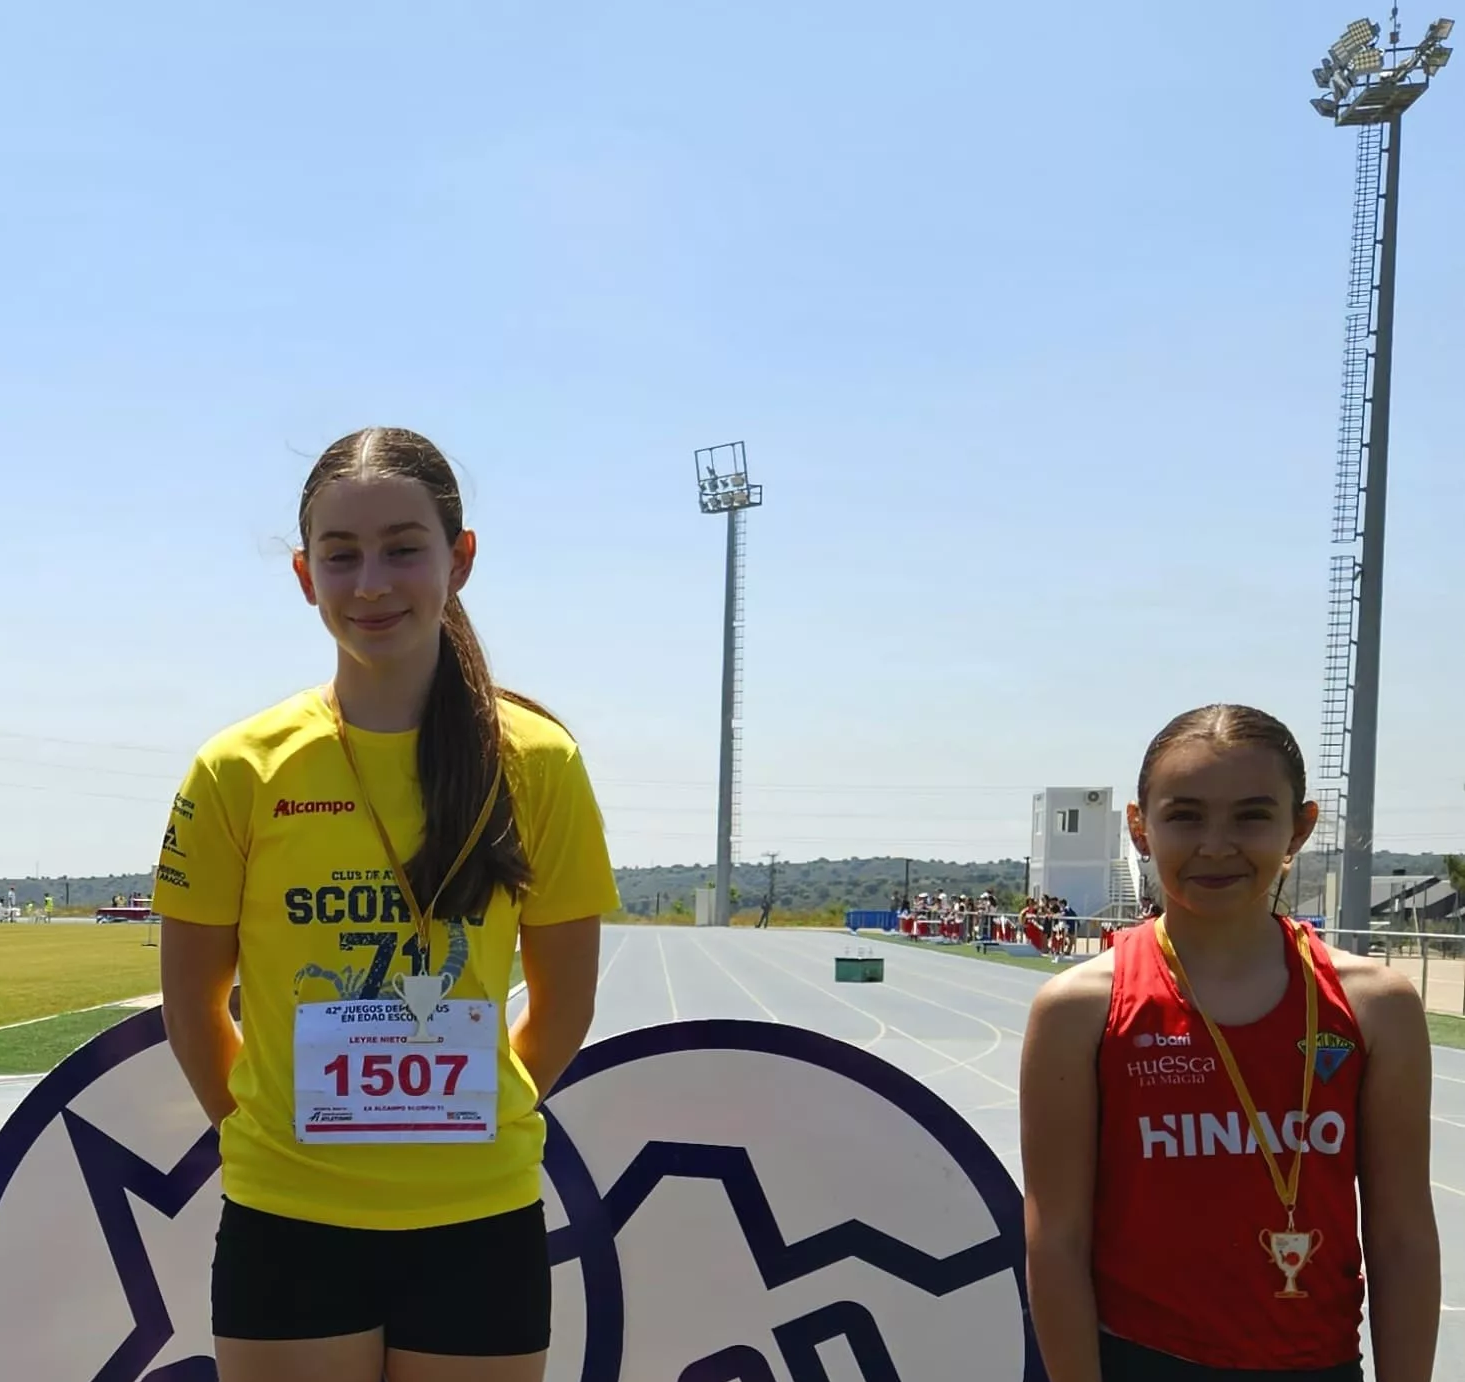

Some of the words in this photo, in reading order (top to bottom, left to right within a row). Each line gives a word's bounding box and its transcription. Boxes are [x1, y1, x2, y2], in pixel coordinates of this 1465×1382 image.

[273, 799, 355, 818] Alcampo
[332, 871, 362, 880] CLUB
[285, 884, 484, 926] SCOR
[344, 1004, 384, 1014] JUEGOS
[341, 1014, 355, 1023] EN
[358, 1013, 385, 1022] EDAD
[349, 1036, 376, 1044] LEYRE
[380, 1036, 408, 1044] NIETO
[324, 1054, 469, 1097] 1507
[1138, 1110, 1346, 1159] HINACO
